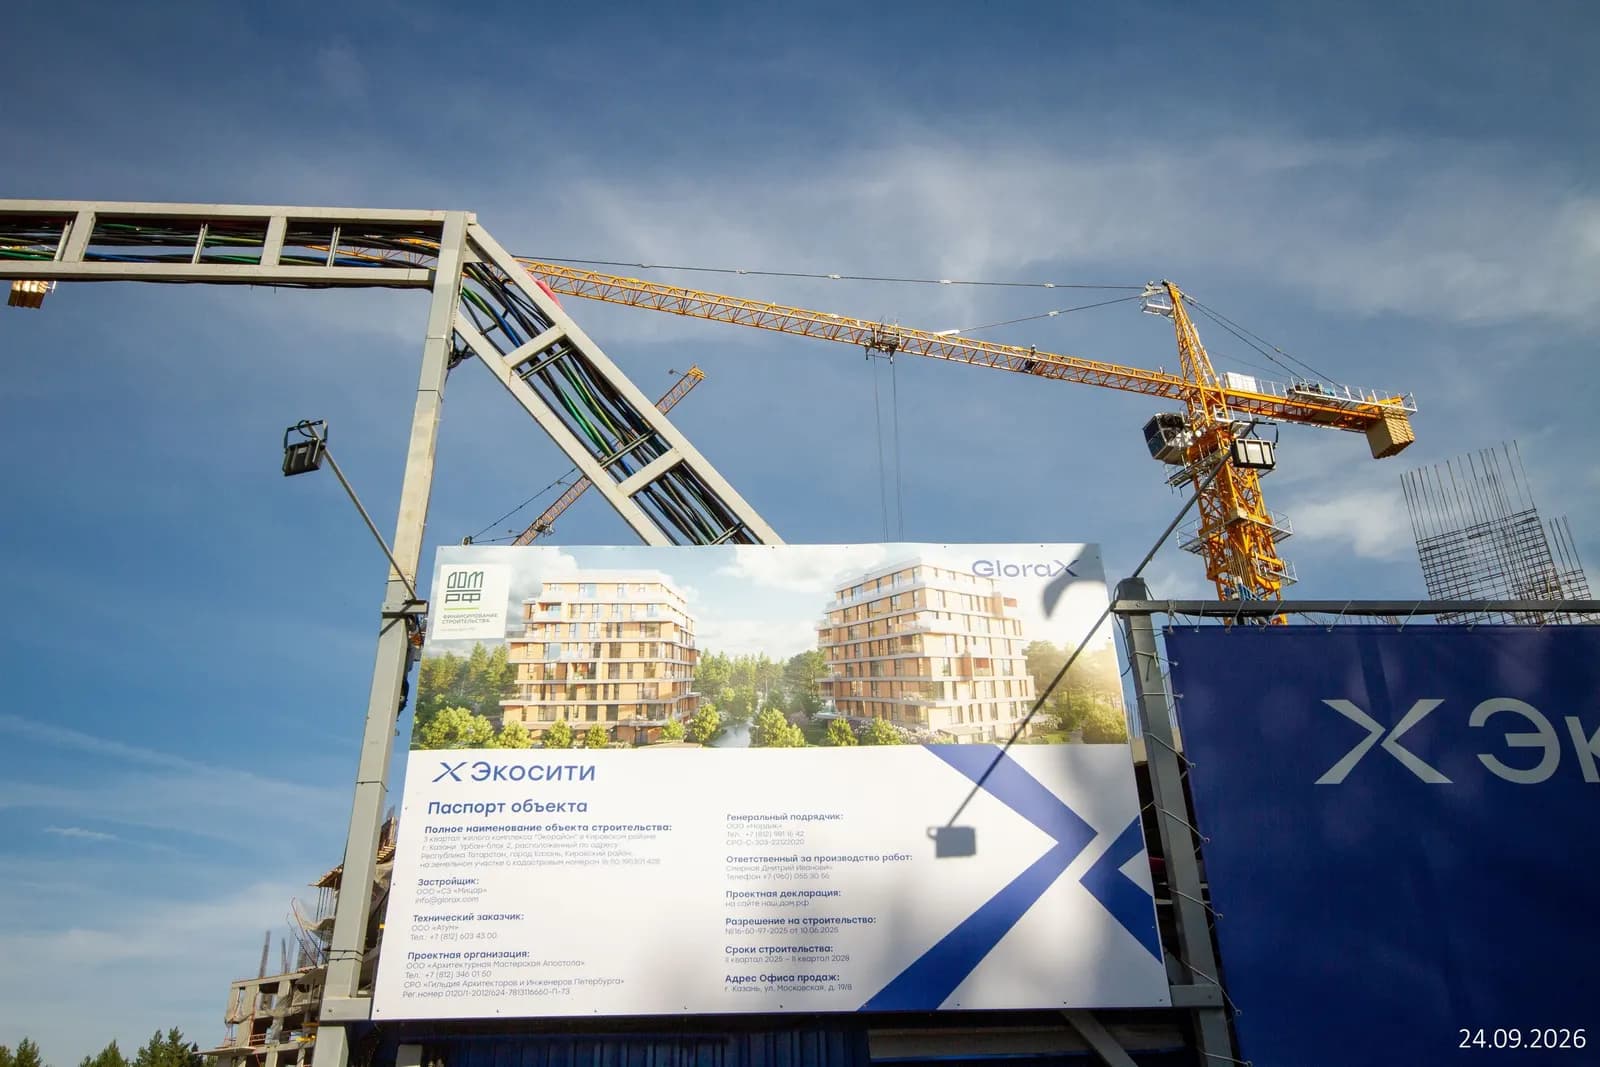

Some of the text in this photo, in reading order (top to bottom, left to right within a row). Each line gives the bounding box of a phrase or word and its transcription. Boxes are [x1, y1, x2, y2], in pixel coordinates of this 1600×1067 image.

[446, 571, 484, 588] ДОМ
[444, 593, 480, 604] РФ
[470, 761, 596, 782] Экосити
[428, 798, 588, 817] Паспорт объекта
[726, 813, 844, 823] Генеральный подрядчик:
[424, 824, 672, 834] Полное наименование объекта строительства:
[726, 854, 798, 863] Ответственный
[814, 854, 880, 864] производство
[882, 854, 913, 864] работ:
[418, 876, 480, 888] Застройщик:
[726, 890, 842, 900] Проектная декларация:
[414, 896, 480, 906] info@glorax.com
[726, 900, 736, 908] на
[412, 912, 525, 922] Технический заказчик:
[726, 917, 786, 928] Разрешение
[802, 916, 877, 926] строительство:
[411, 924, 430, 932] ООО
[440, 932, 458, 942] (812)
[486, 932, 498, 940] 00
[725, 945, 834, 956] Сроки строительства:
[408, 951, 530, 962] Проектная организация:
[730, 956, 764, 964] квартал
[798, 954, 830, 964] квартал
[406, 960, 585, 970] ООО «Архитектурная Мастерская Апостола»
[436, 970, 454, 980] (812)
[725, 972, 840, 984] Адрес Офиса продаж:
[403, 980, 421, 988] СРО
[462, 980, 518, 988] Архитекторов
[526, 979, 572, 988] Инженеров
[574, 978, 624, 987] Петербурга»
